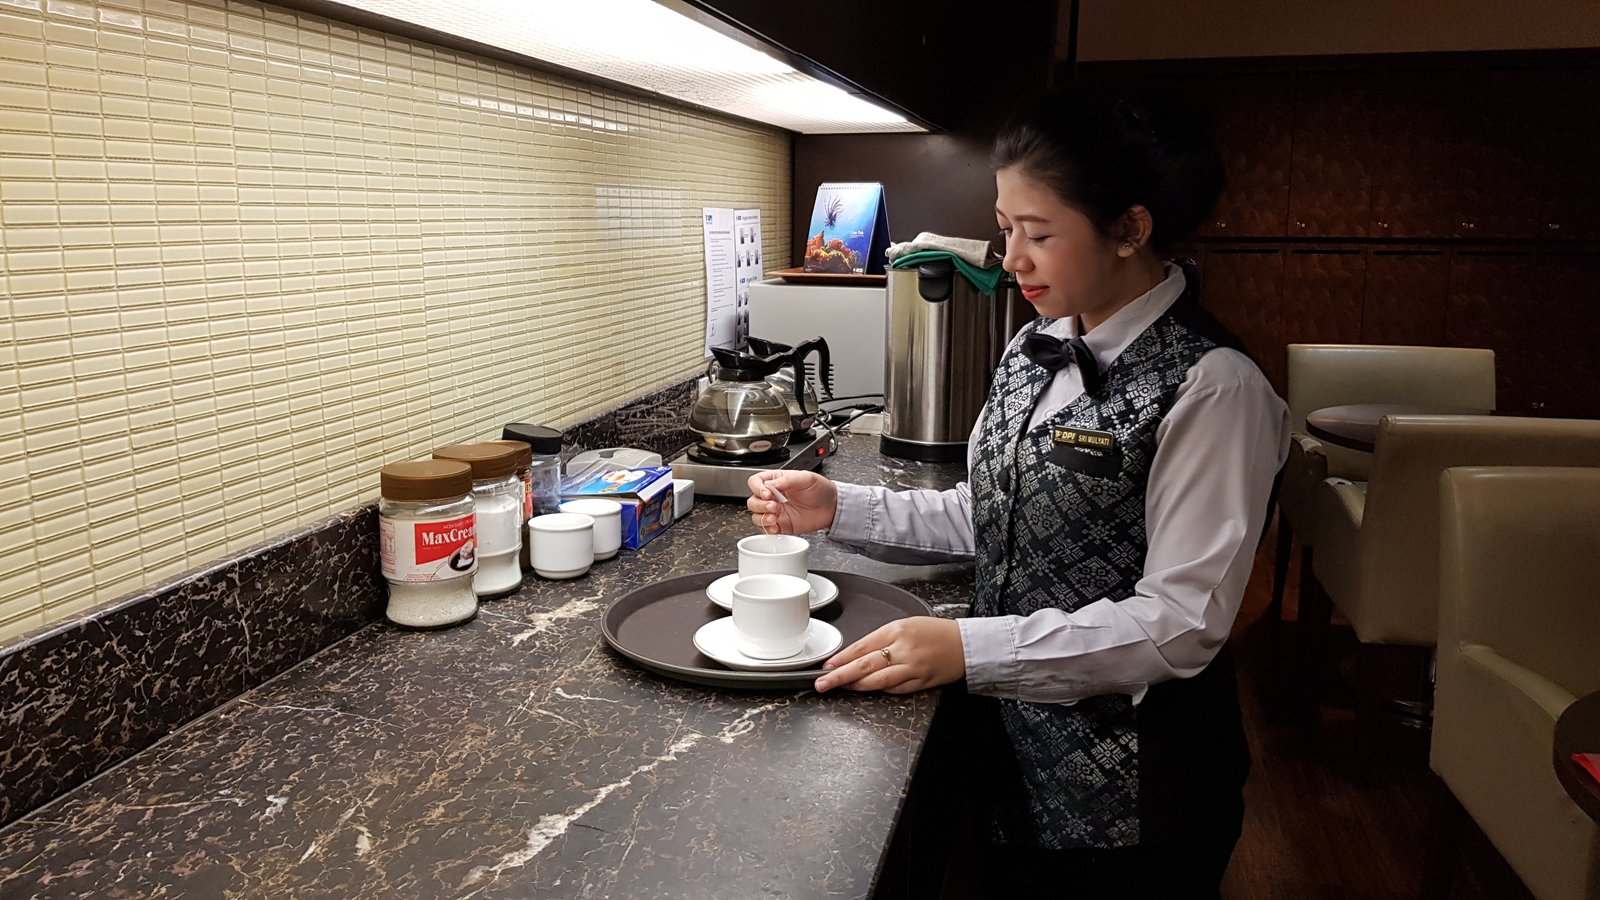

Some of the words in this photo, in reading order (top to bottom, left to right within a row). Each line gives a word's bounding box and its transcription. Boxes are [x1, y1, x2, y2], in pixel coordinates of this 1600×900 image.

[1062, 432, 1076, 440] DPI
[1078, 434, 1088, 442] SRI
[1088, 436, 1110, 445] MULYATI
[422, 526, 476, 546] MaxCrea
